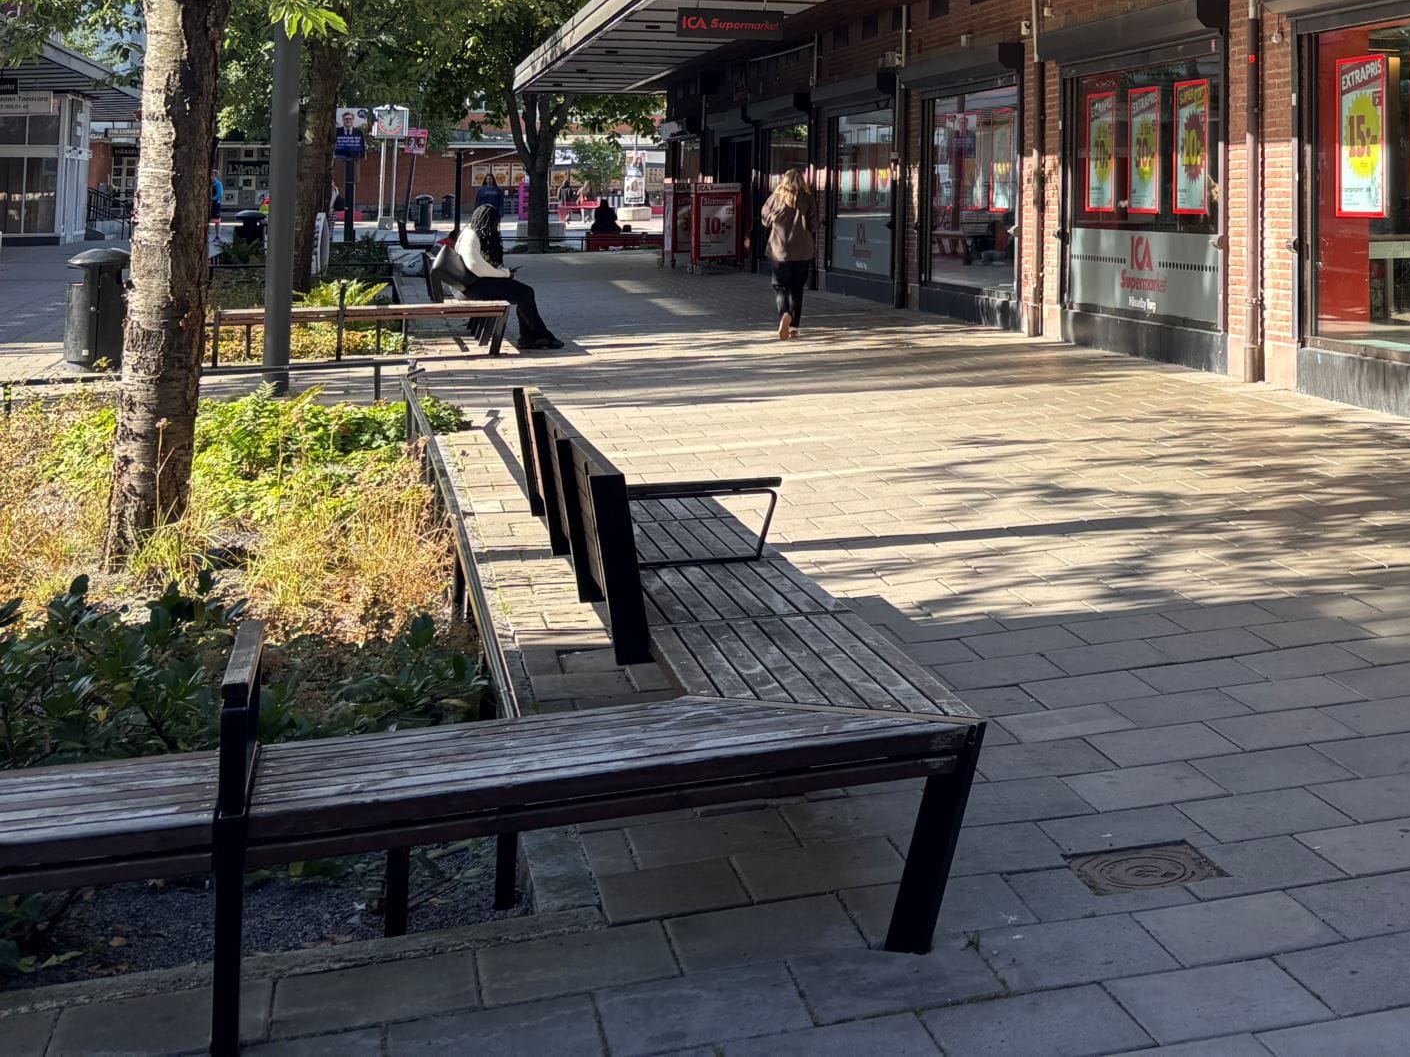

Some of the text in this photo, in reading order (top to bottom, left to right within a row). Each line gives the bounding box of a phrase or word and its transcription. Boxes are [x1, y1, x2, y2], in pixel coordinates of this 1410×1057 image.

[682, 15, 779, 31] ICA Supermarket
[1341, 61, 1382, 90] EXTRAPRIS
[1348, 115, 1378, 158] 15:-
[705, 217, 732, 236] 10:-
[1130, 235, 1153, 272] ICA
